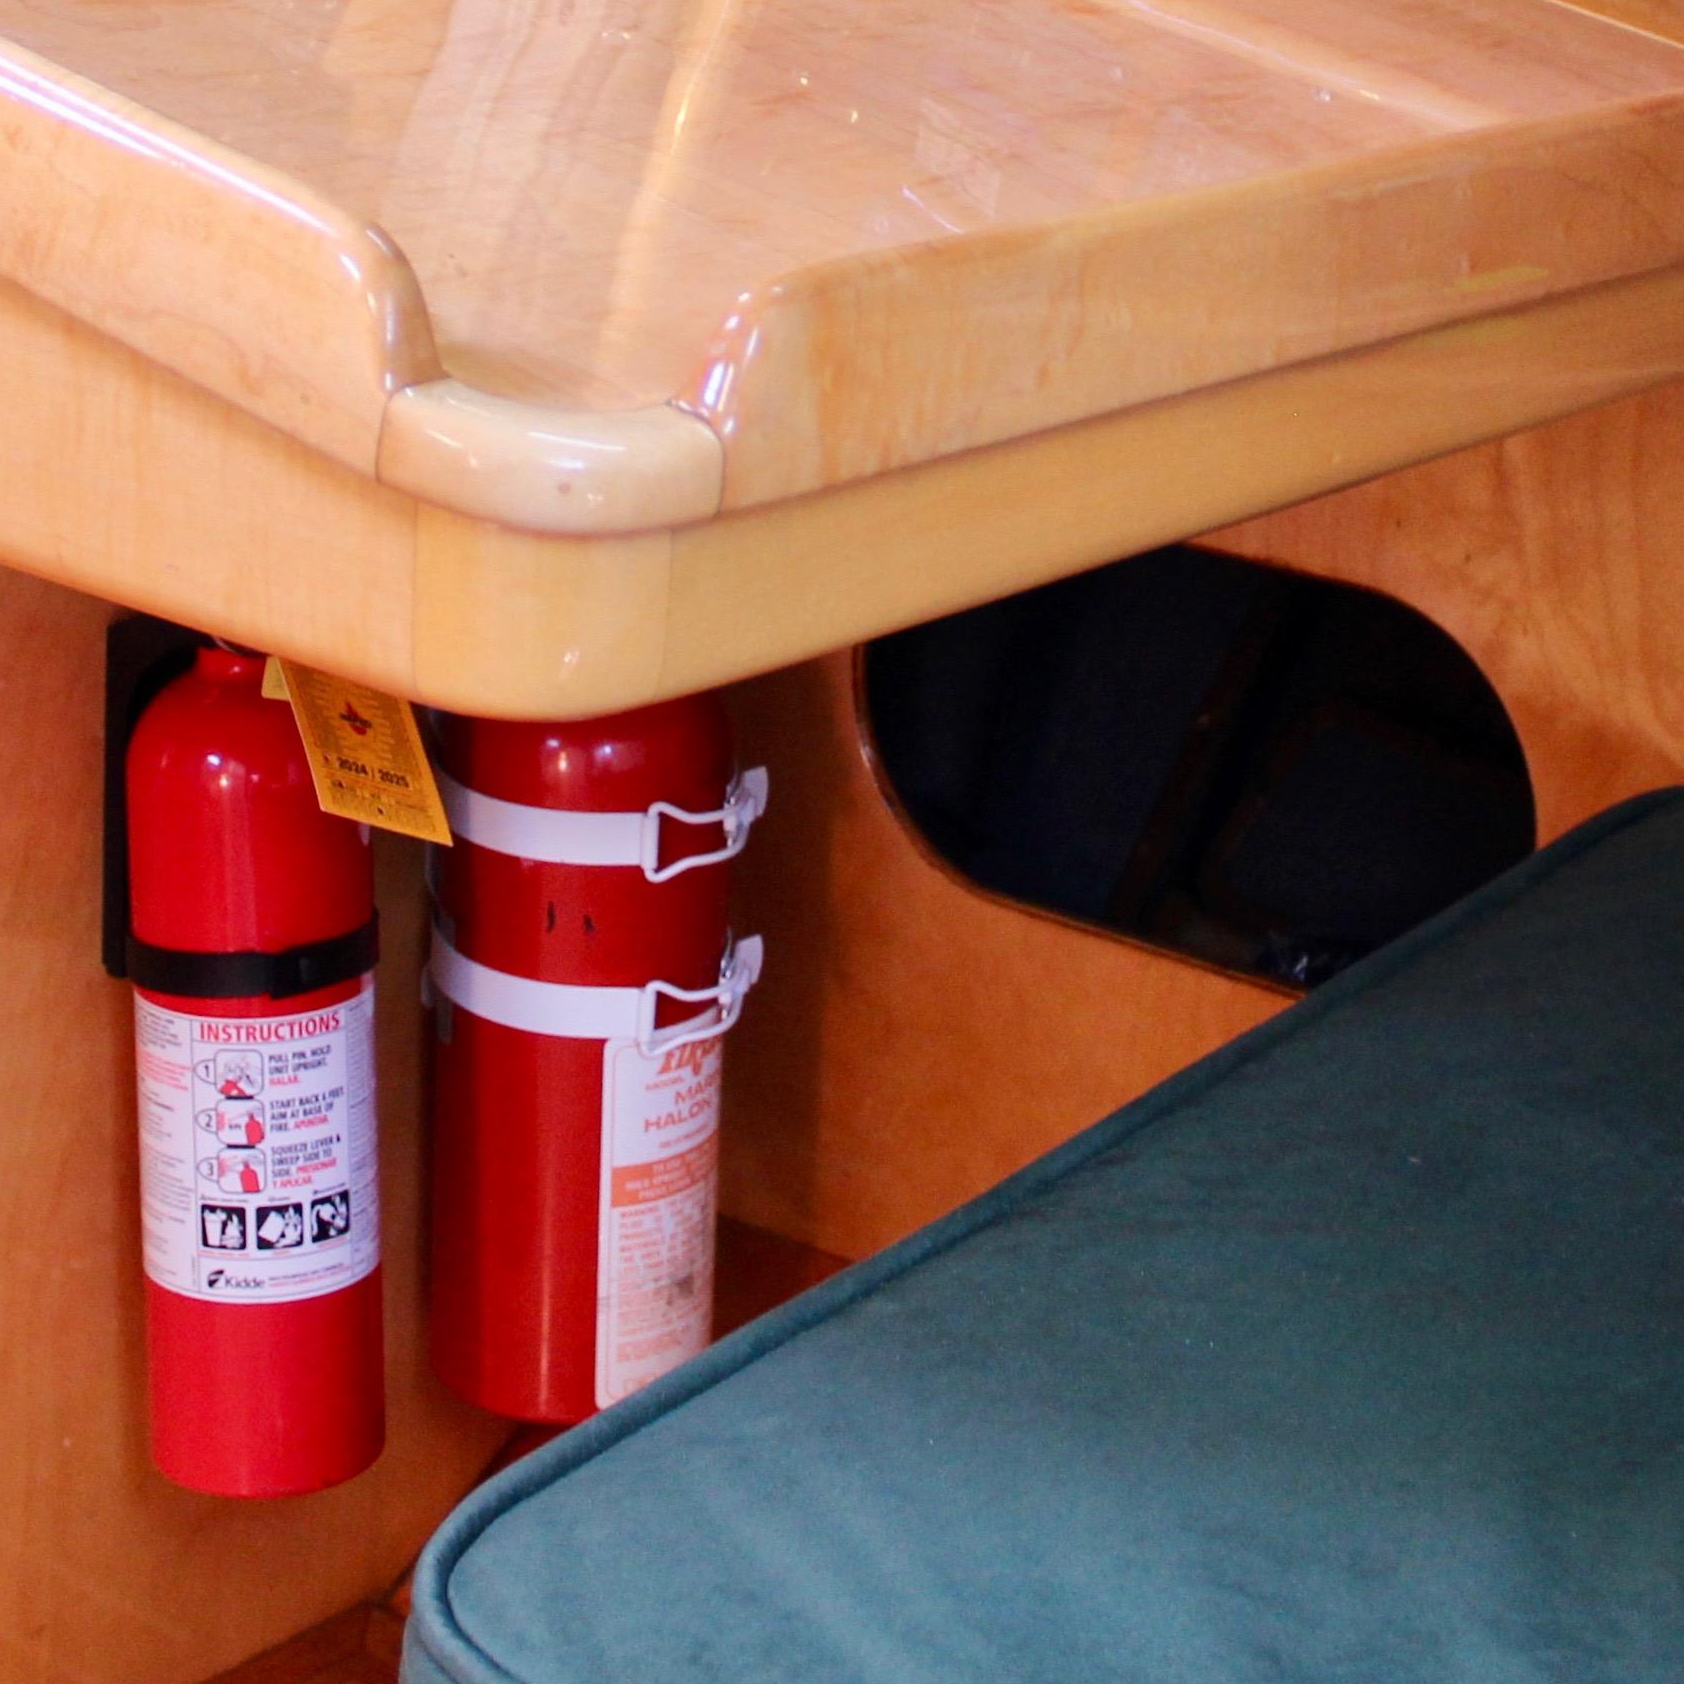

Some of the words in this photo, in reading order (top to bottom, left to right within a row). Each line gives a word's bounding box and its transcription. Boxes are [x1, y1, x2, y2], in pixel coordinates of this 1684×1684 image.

[200, 1012, 340, 1043] INSTRUCTIONS
[204, 1064, 210, 1078] 1
[270, 1098, 296, 1110] START
[205, 1114, 213, 1127] 2
[644, 1097, 712, 1133] HALON
[271, 1143, 308, 1156] SQUEEZE
[272, 1155, 300, 1166] SWEEP
[208, 1163, 214, 1176] 3
[224, 1275, 265, 1289] Kidde
